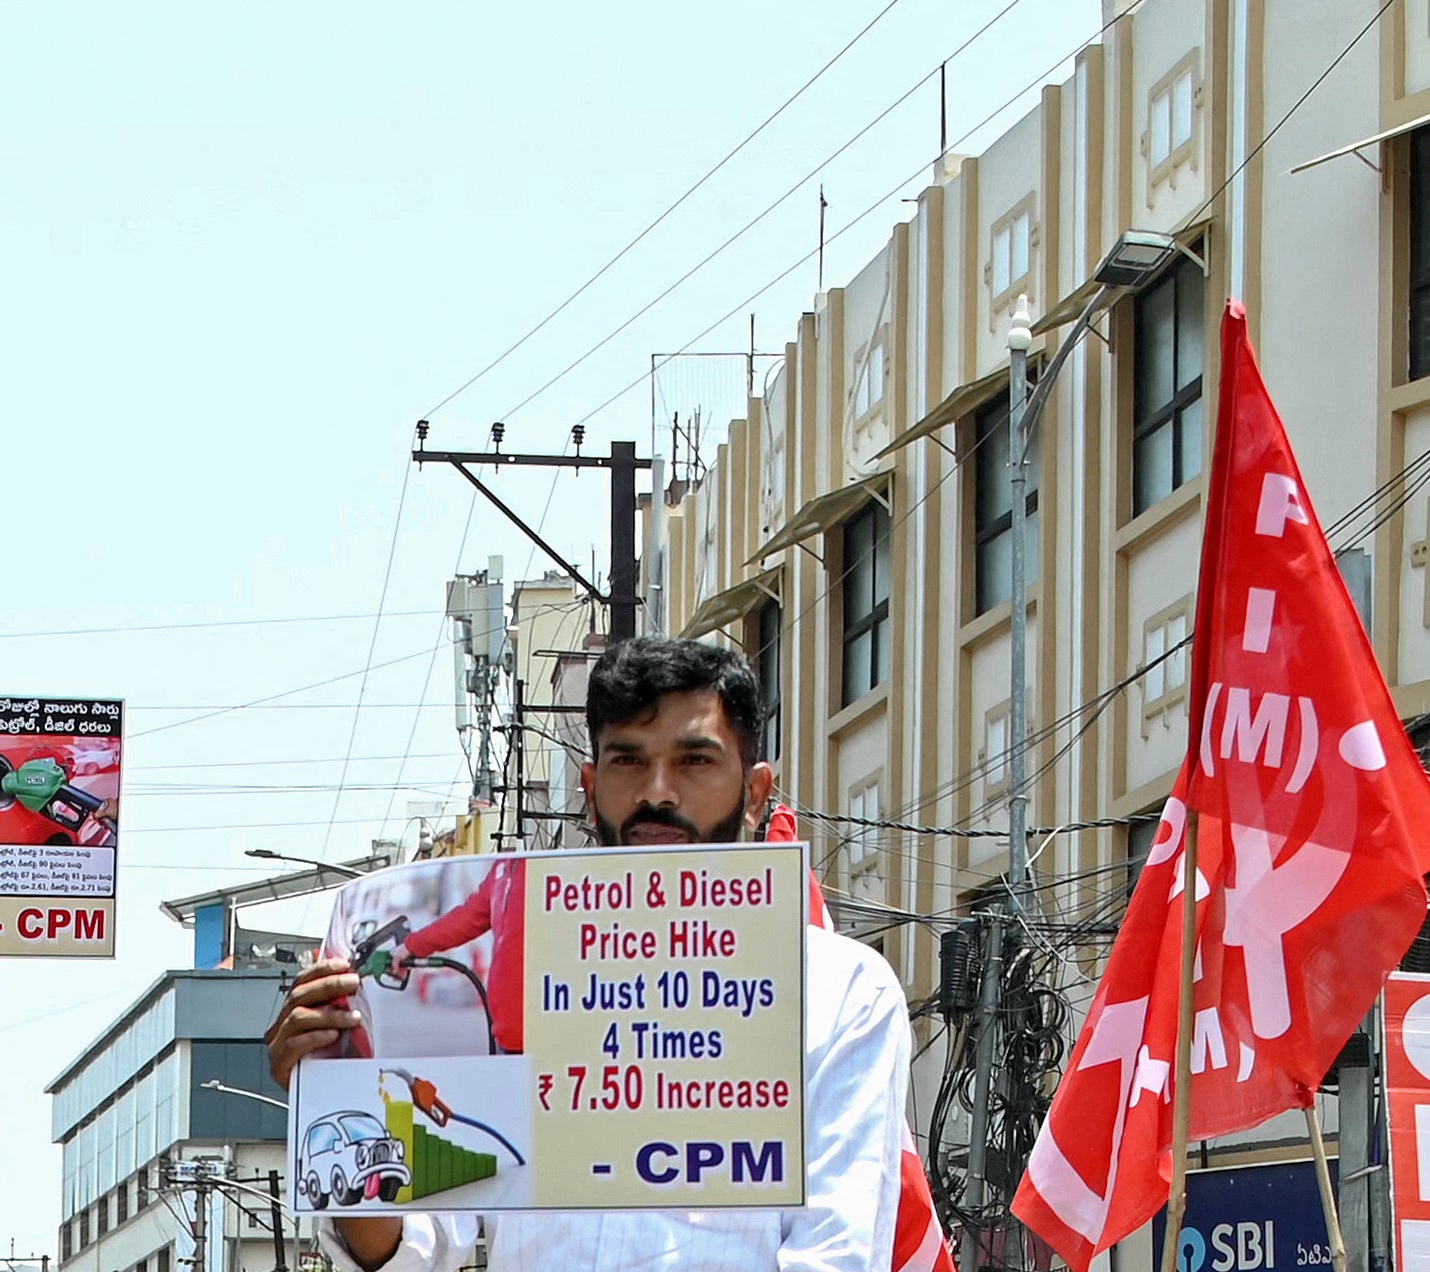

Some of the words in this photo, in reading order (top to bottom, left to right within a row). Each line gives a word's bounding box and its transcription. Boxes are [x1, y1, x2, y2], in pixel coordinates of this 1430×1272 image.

[545, 872, 633, 912] Petrol
[647, 874, 666, 907] &
[679, 868, 773, 907] Diesel
[17, 909, 106, 939] CPM
[579, 923, 657, 961] Price
[669, 920, 736, 956] Hike
[543, 974, 571, 1011] In
[581, 972, 646, 1011] Just
[656, 970, 688, 1009] 10
[702, 971, 775, 1017] Days
[602, 1023, 620, 1059] 4
[631, 1023, 723, 1059] Times
[567, 1065, 643, 1111] 7.50
[656, 1072, 789, 1109] Increase
[635, 1141, 784, 1184] CPM
[1211, 1219, 1274, 1272] SBI
